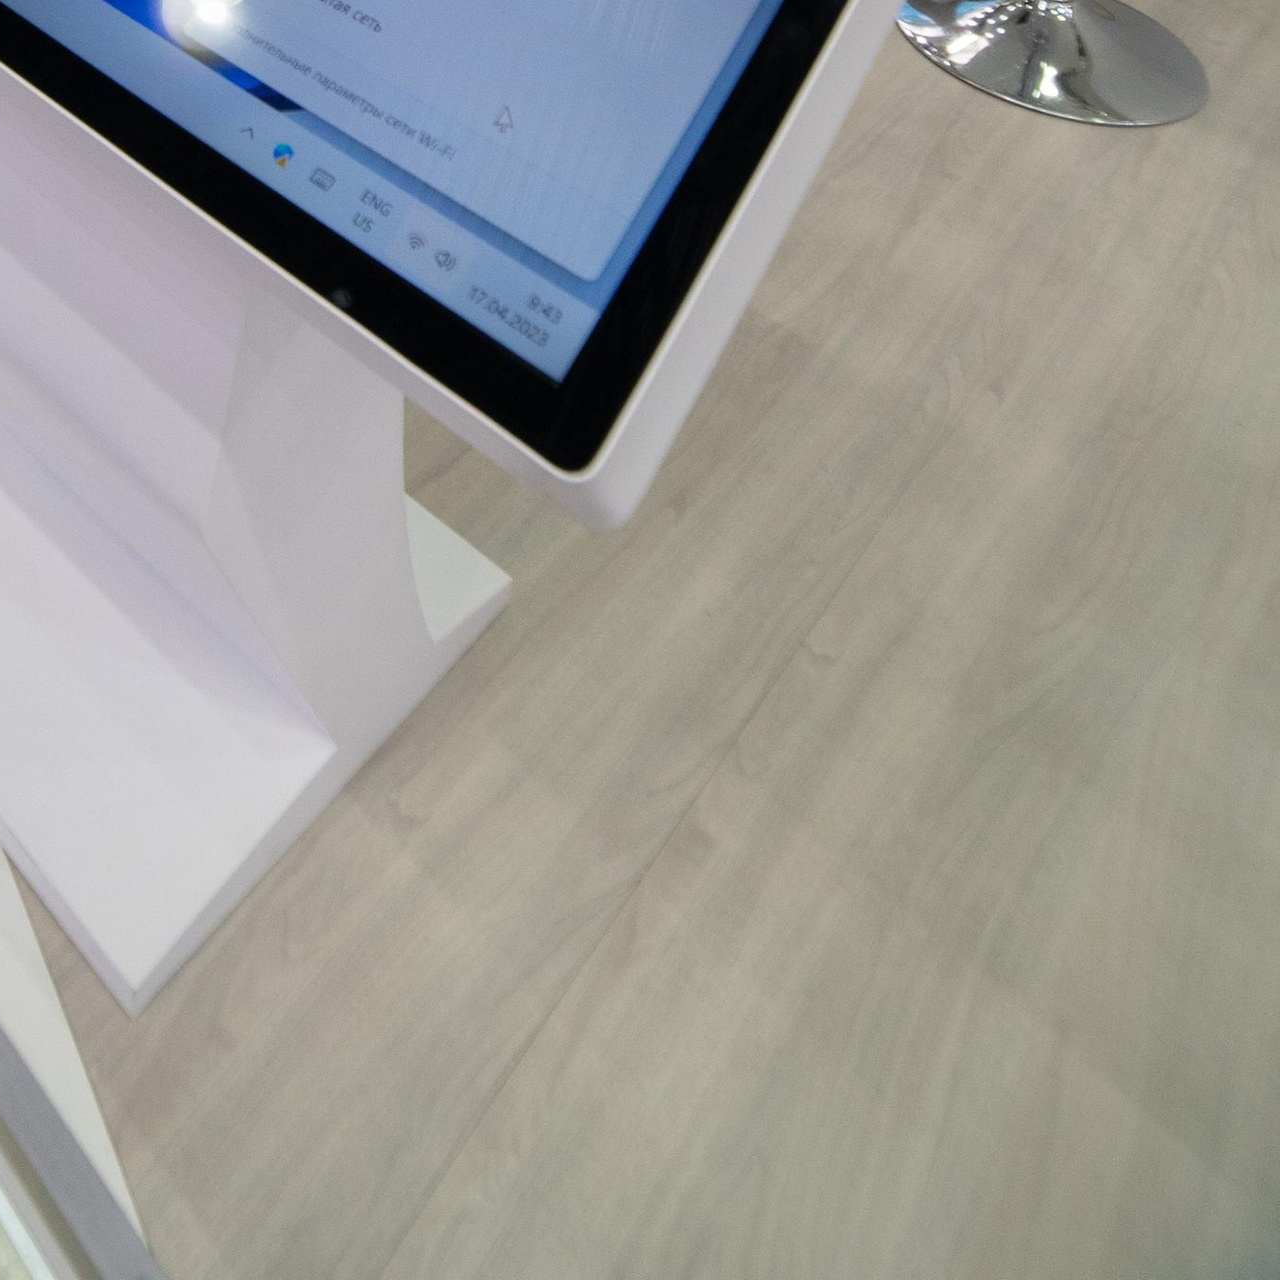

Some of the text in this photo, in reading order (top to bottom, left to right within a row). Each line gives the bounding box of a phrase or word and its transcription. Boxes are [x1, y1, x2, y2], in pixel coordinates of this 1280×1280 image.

[352, 10, 382, 34] сеть
[418, 133, 457, 162] Wi-Fi
[361, 190, 393, 218] ENG
[352, 212, 374, 233] US
